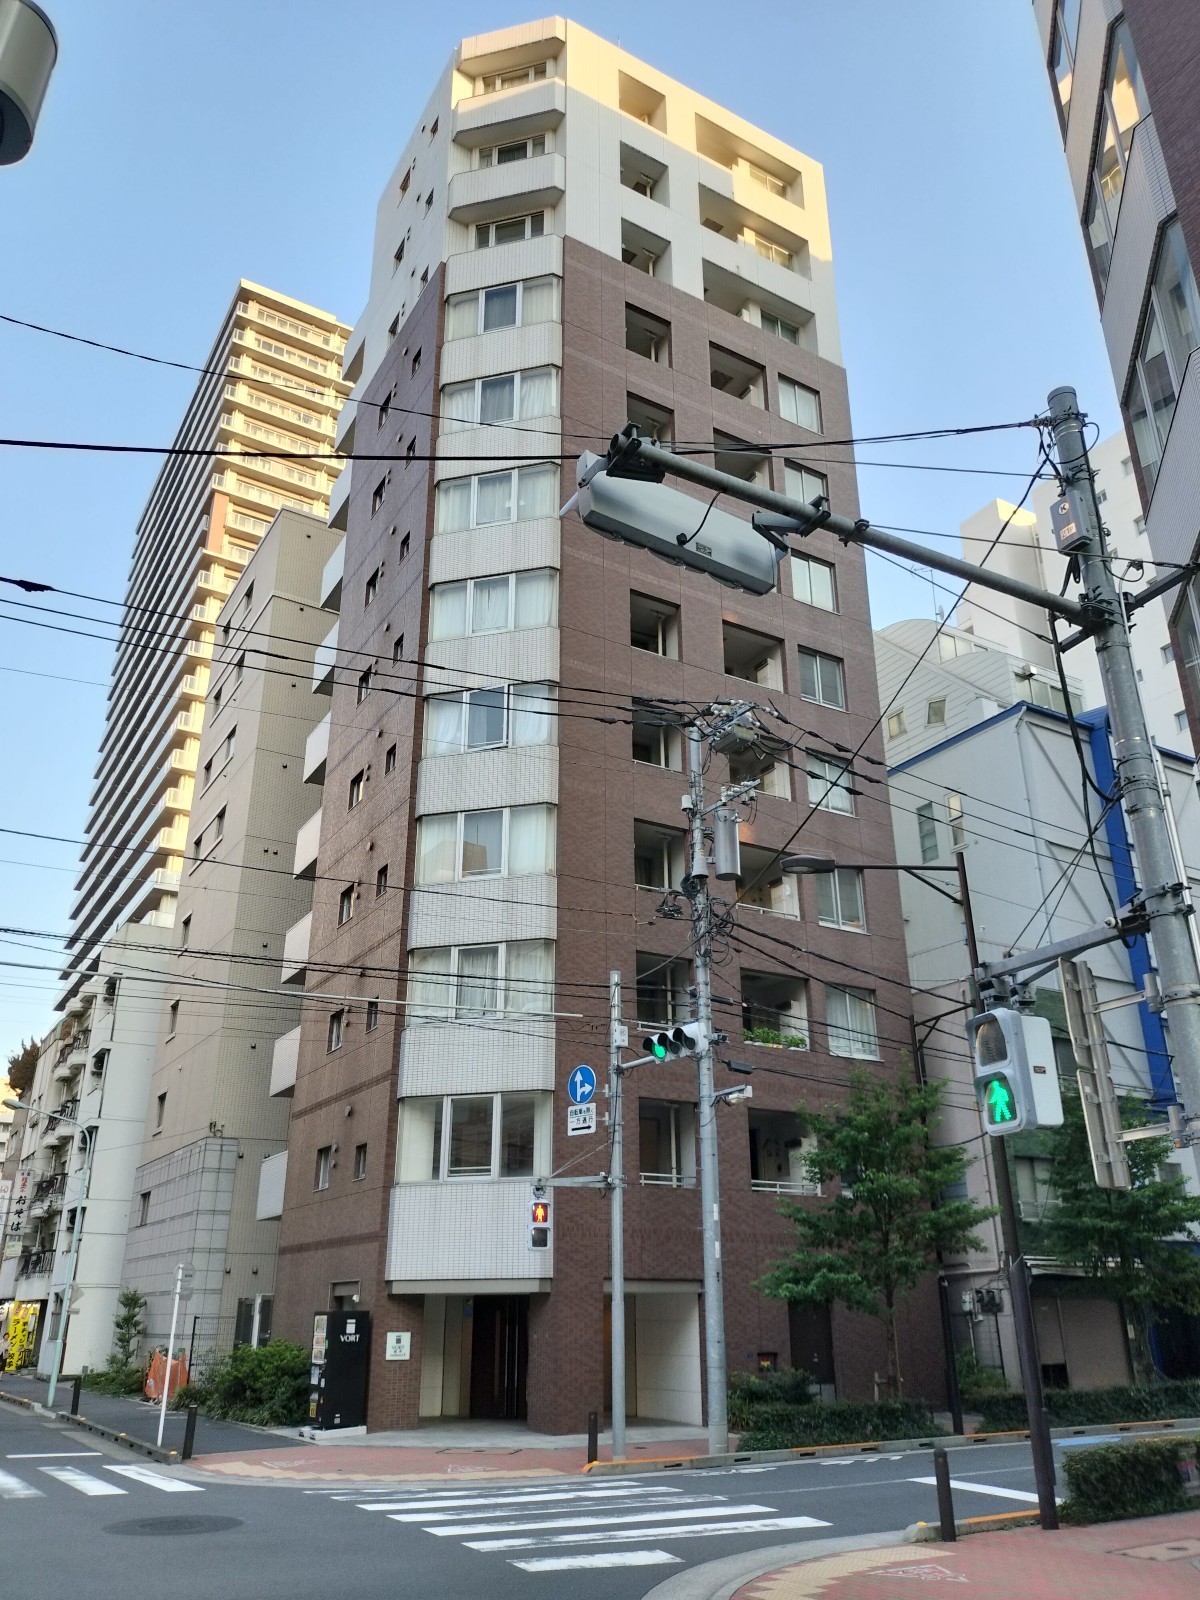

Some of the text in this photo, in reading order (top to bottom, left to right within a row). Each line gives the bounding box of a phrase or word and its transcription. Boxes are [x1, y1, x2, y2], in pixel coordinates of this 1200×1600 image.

[569, 1116, 594, 1126] 一方通行
[11, 1196, 27, 1232] おそば
[340, 1334, 360, 1343] VORT
